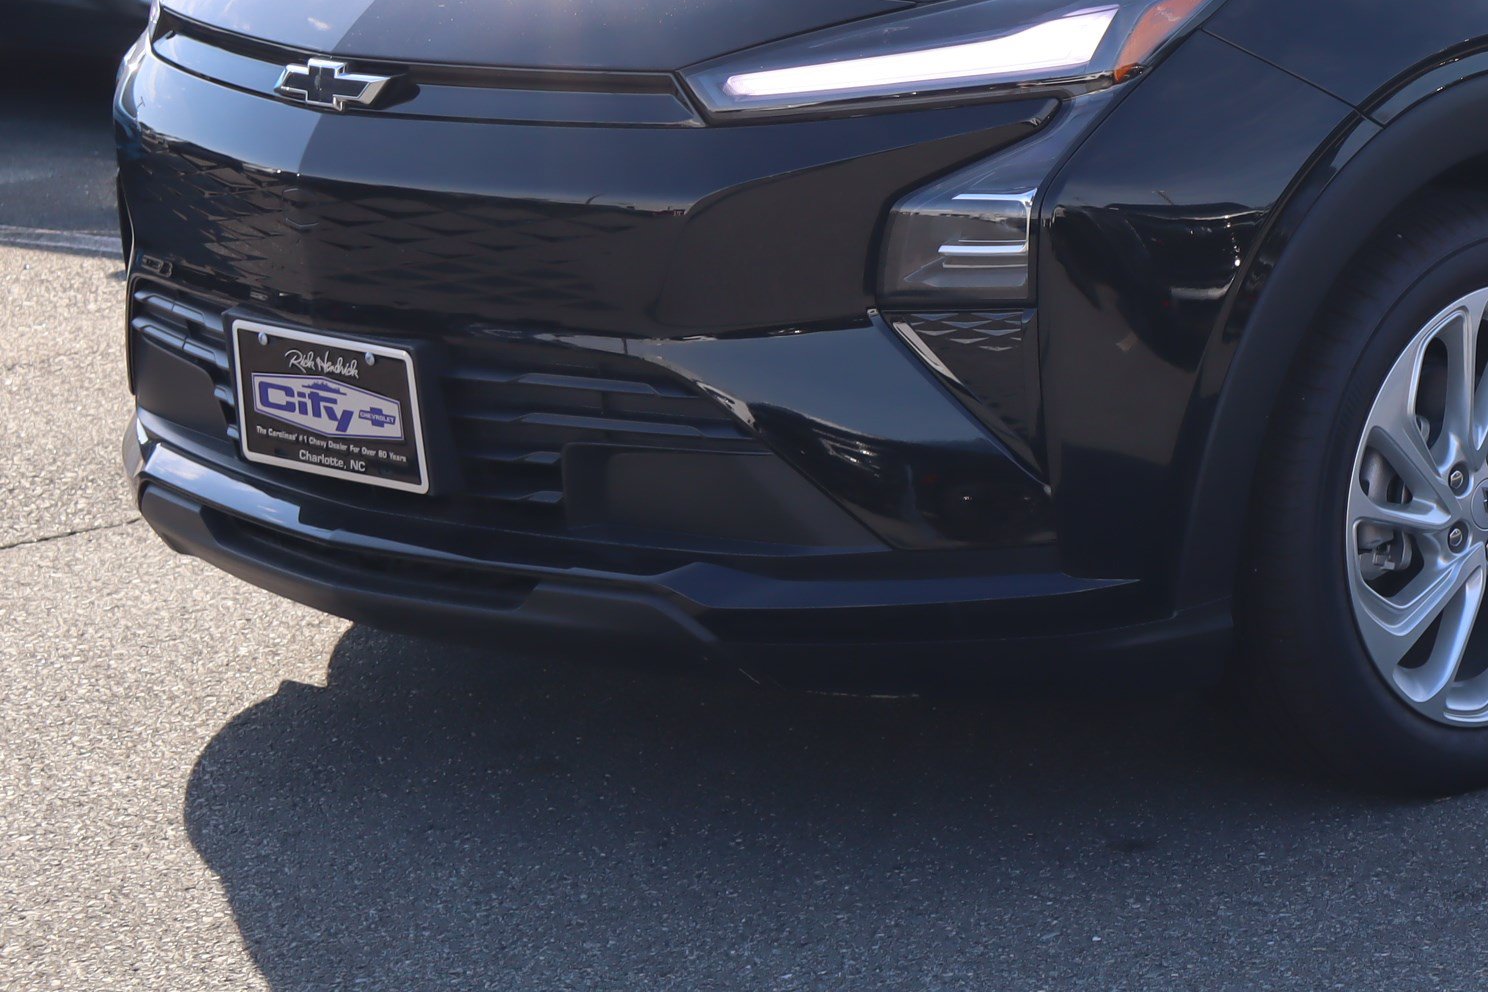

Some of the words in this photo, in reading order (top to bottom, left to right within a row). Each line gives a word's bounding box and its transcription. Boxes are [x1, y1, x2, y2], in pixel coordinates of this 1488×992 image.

[285, 349, 316, 373] Rick
[359, 411, 395, 424] CHEVROLET
[256, 425, 267, 435] The
[309, 436, 327, 449] Chevy
[328, 440, 348, 451] Dealer
[350, 444, 360, 453] For
[361, 446, 376, 456] Over
[389, 451, 407, 462] Years
[299, 450, 347, 469] Charlotte,
[350, 459, 366, 472] NC
